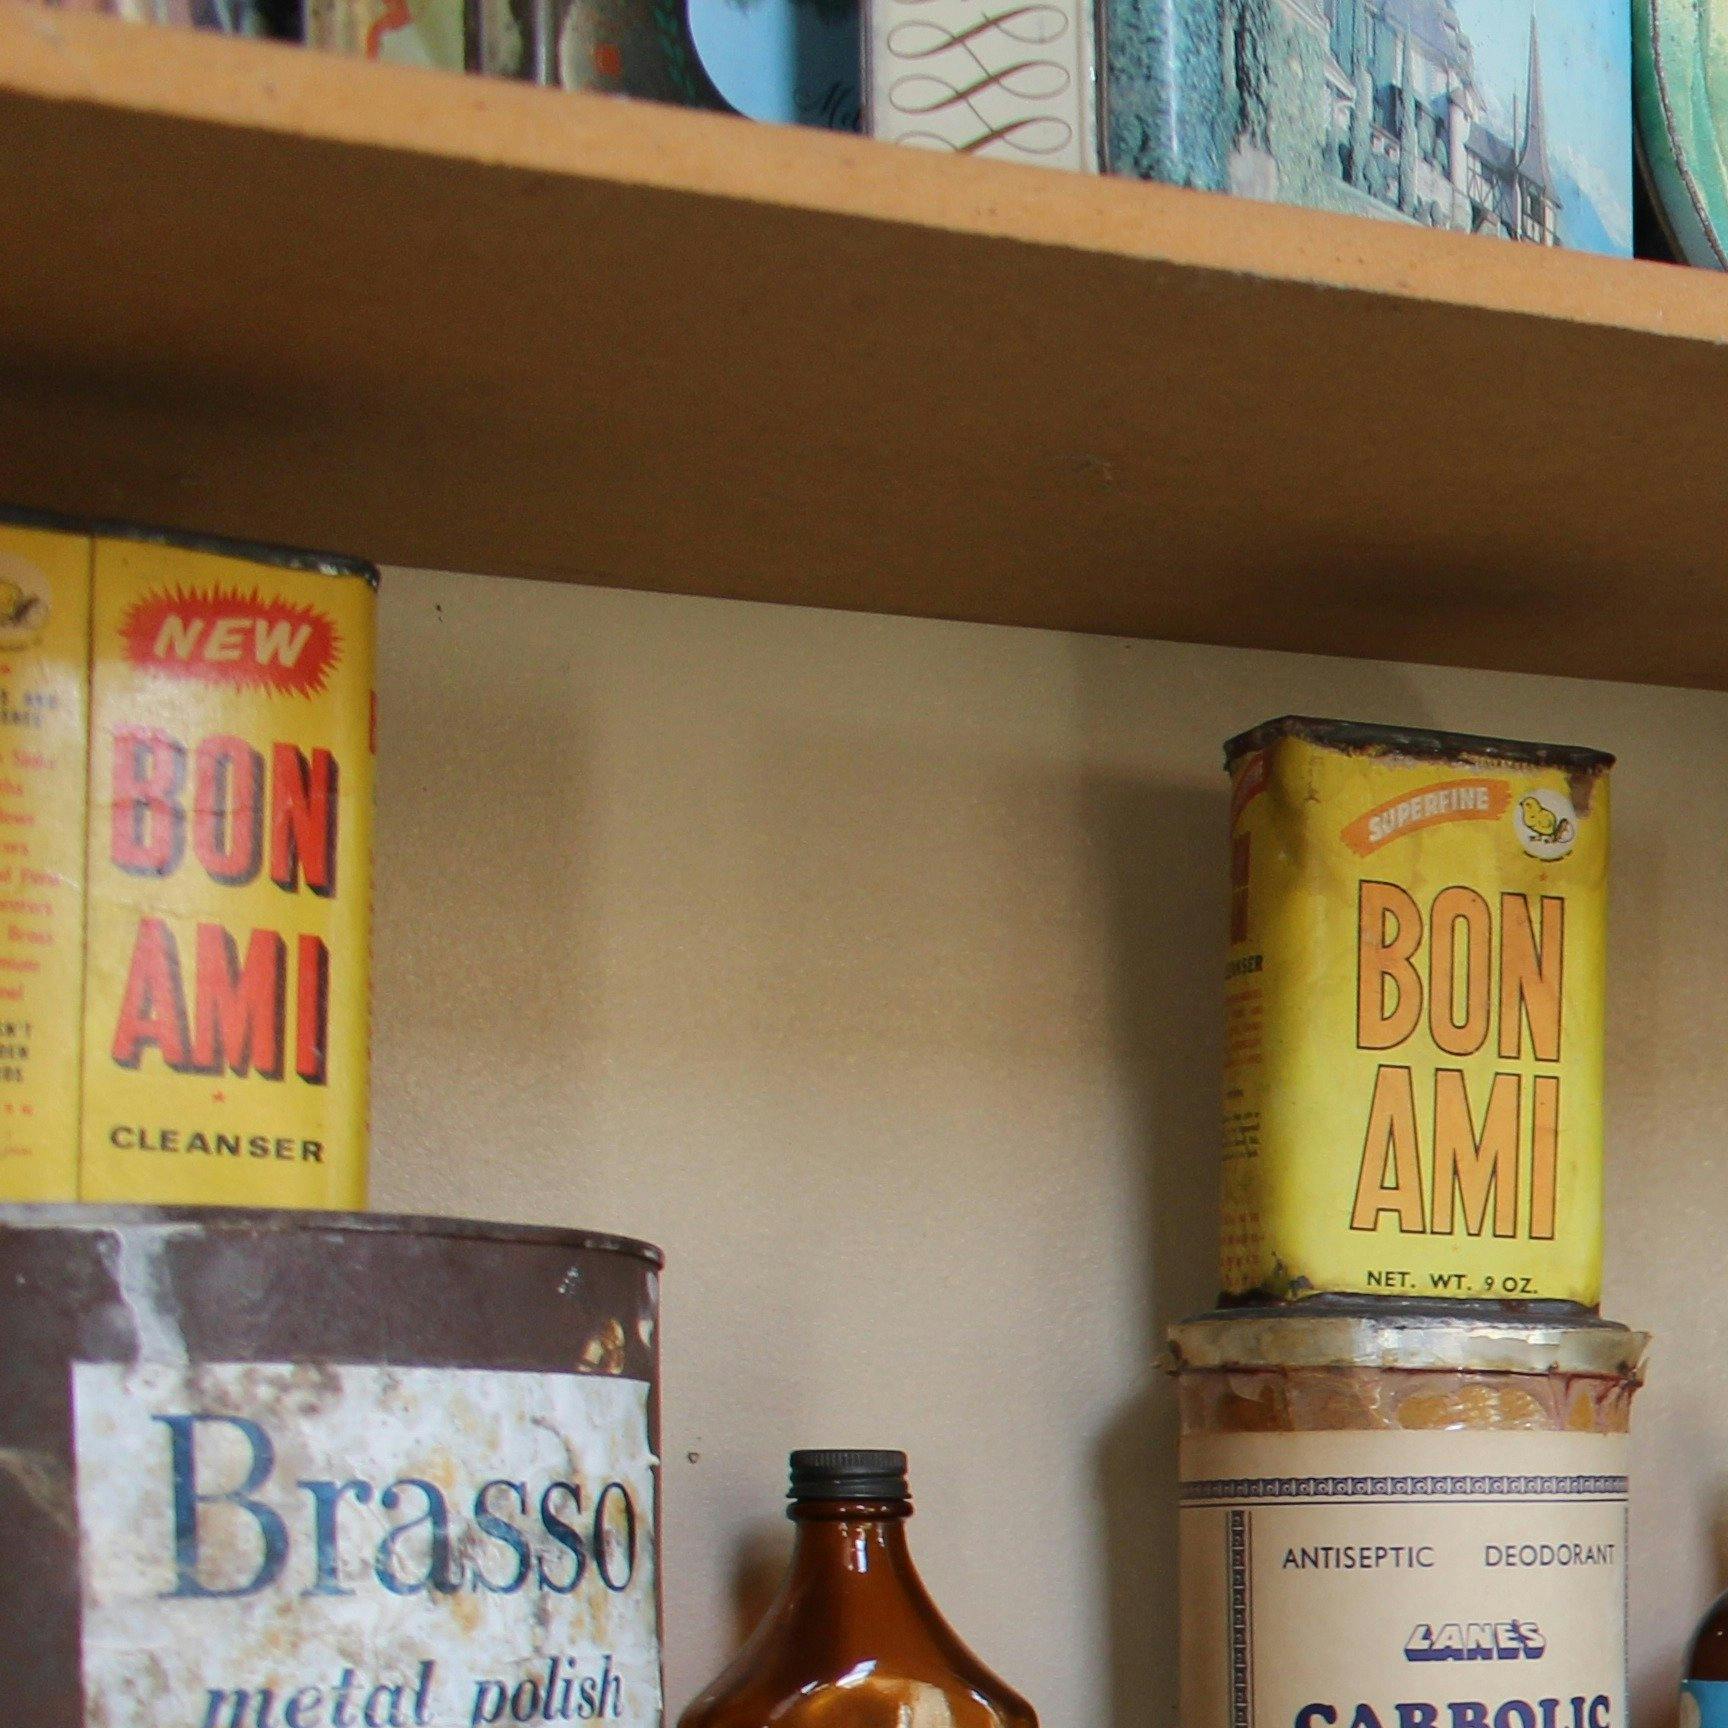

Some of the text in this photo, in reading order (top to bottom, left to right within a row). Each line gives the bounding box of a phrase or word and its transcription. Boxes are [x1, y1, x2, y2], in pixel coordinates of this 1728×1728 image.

[153, 613, 312, 670] NEW
[111, 725, 339, 898] BON
[1367, 785, 1491, 843] SUPERFINE
[111, 914, 330, 1085] AMI
[1356, 879, 1565, 1063] BON
[110, 1124, 325, 1164] CLEANSER
[1349, 1064, 1559, 1240] AMI
[1366, 1269, 1538, 1294] NET. WT. 9 OZ.
[151, 1411, 638, 1600] Brasso
[1282, 1542, 1616, 1570] ANTISEPTIC DEODORANT
